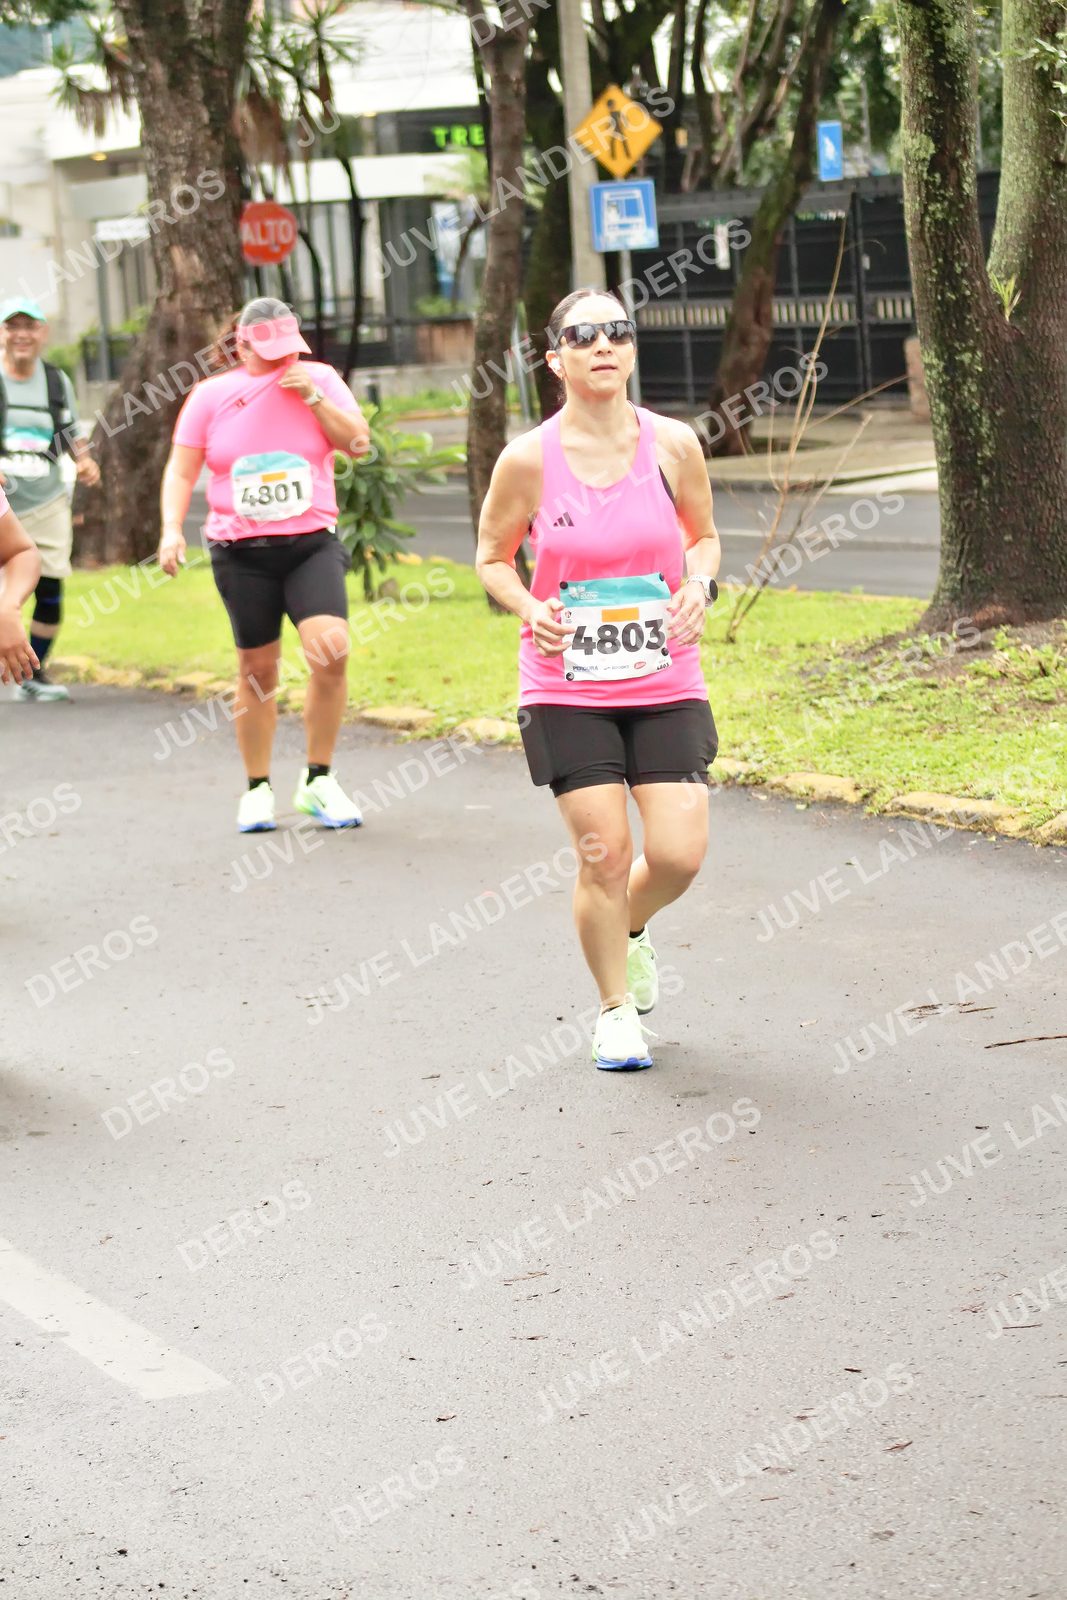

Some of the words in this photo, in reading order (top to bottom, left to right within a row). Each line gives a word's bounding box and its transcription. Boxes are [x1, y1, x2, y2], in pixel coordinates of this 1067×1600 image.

[242, 220, 293, 245] ALTO
[242, 481, 304, 506] 4801
[572, 619, 666, 655] 4803
